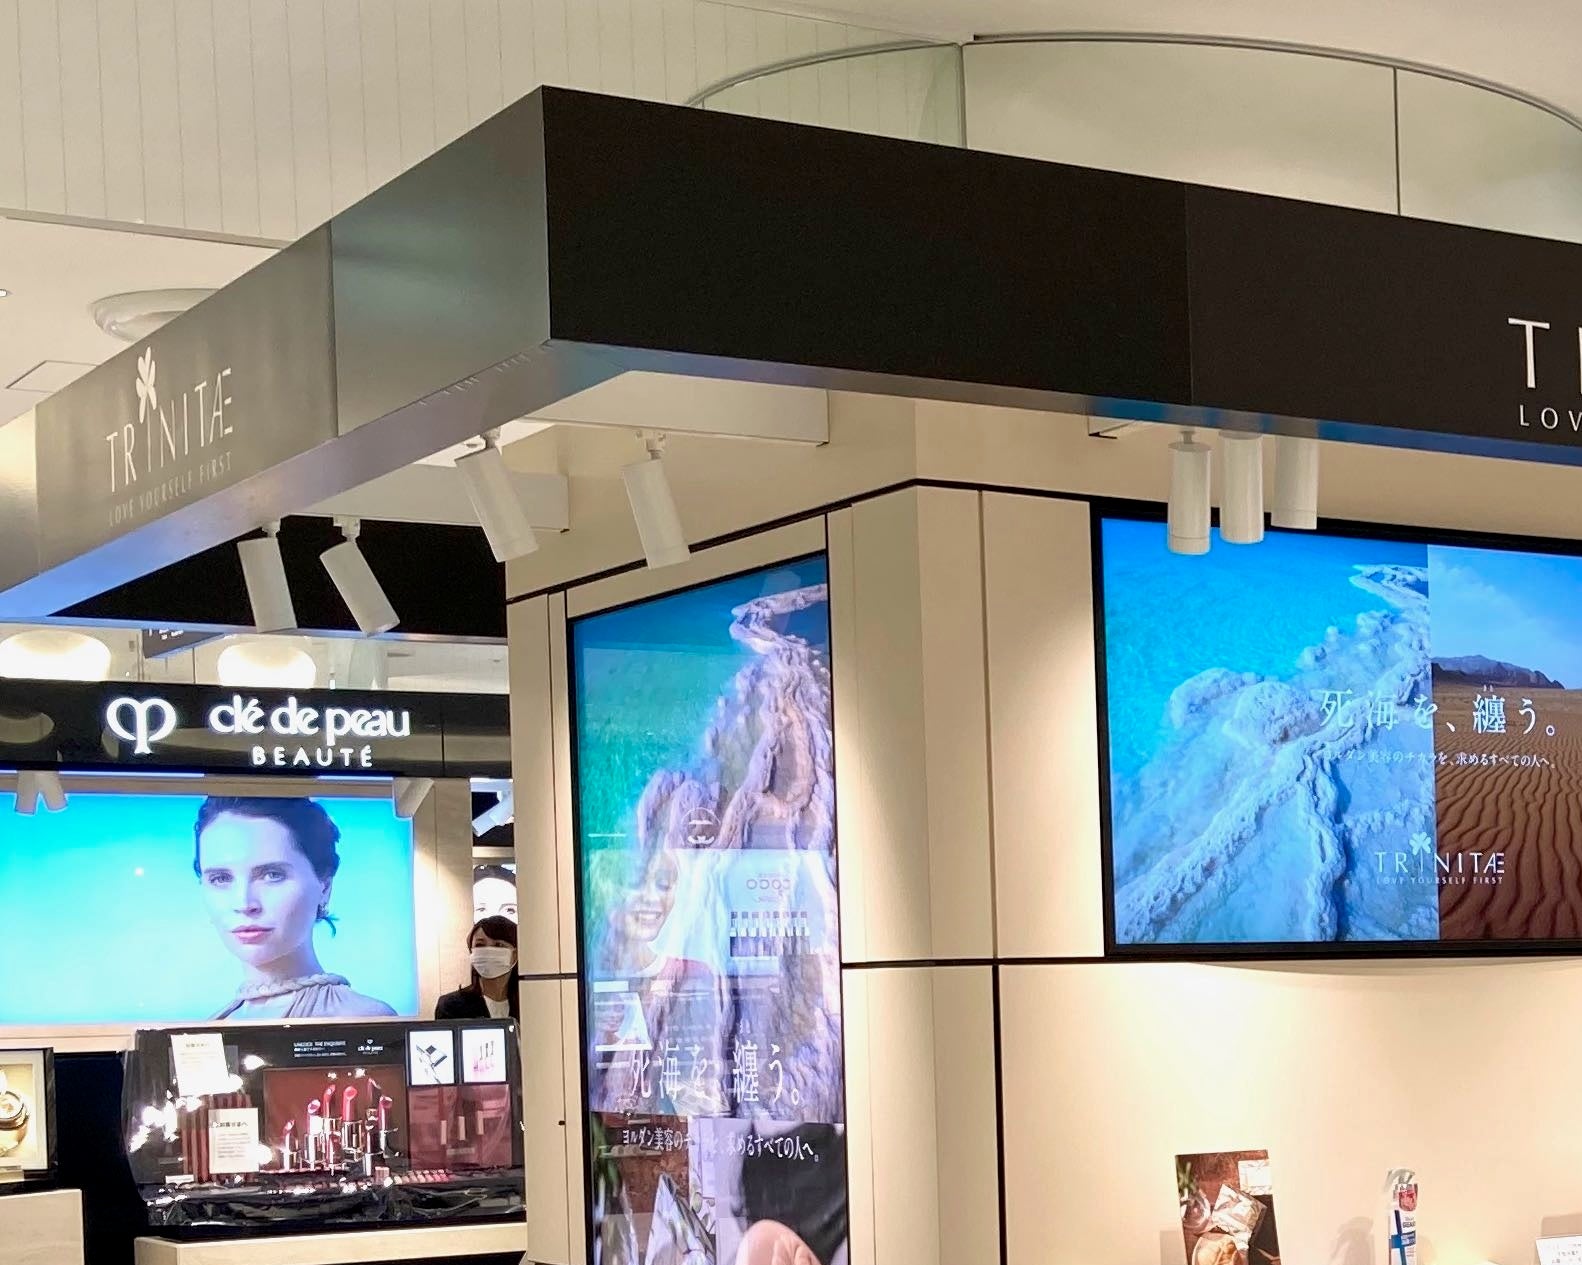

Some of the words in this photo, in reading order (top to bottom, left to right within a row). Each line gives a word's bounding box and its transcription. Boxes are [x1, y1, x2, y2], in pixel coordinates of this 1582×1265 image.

[109, 499, 134, 527] LOVE
[141, 470, 193, 513] YOURSELF
[200, 451, 232, 484] FIRST
[208, 694, 265, 735] clé
[270, 696, 319, 735] de
[325, 707, 410, 747] peau
[252, 745, 372, 768] BEAUTÉ
[1411, 876, 1466, 886] YOURSELF
[1473, 876, 1503, 885] FIRST
[629, 1040, 800, 1105] 死海を纏う。
